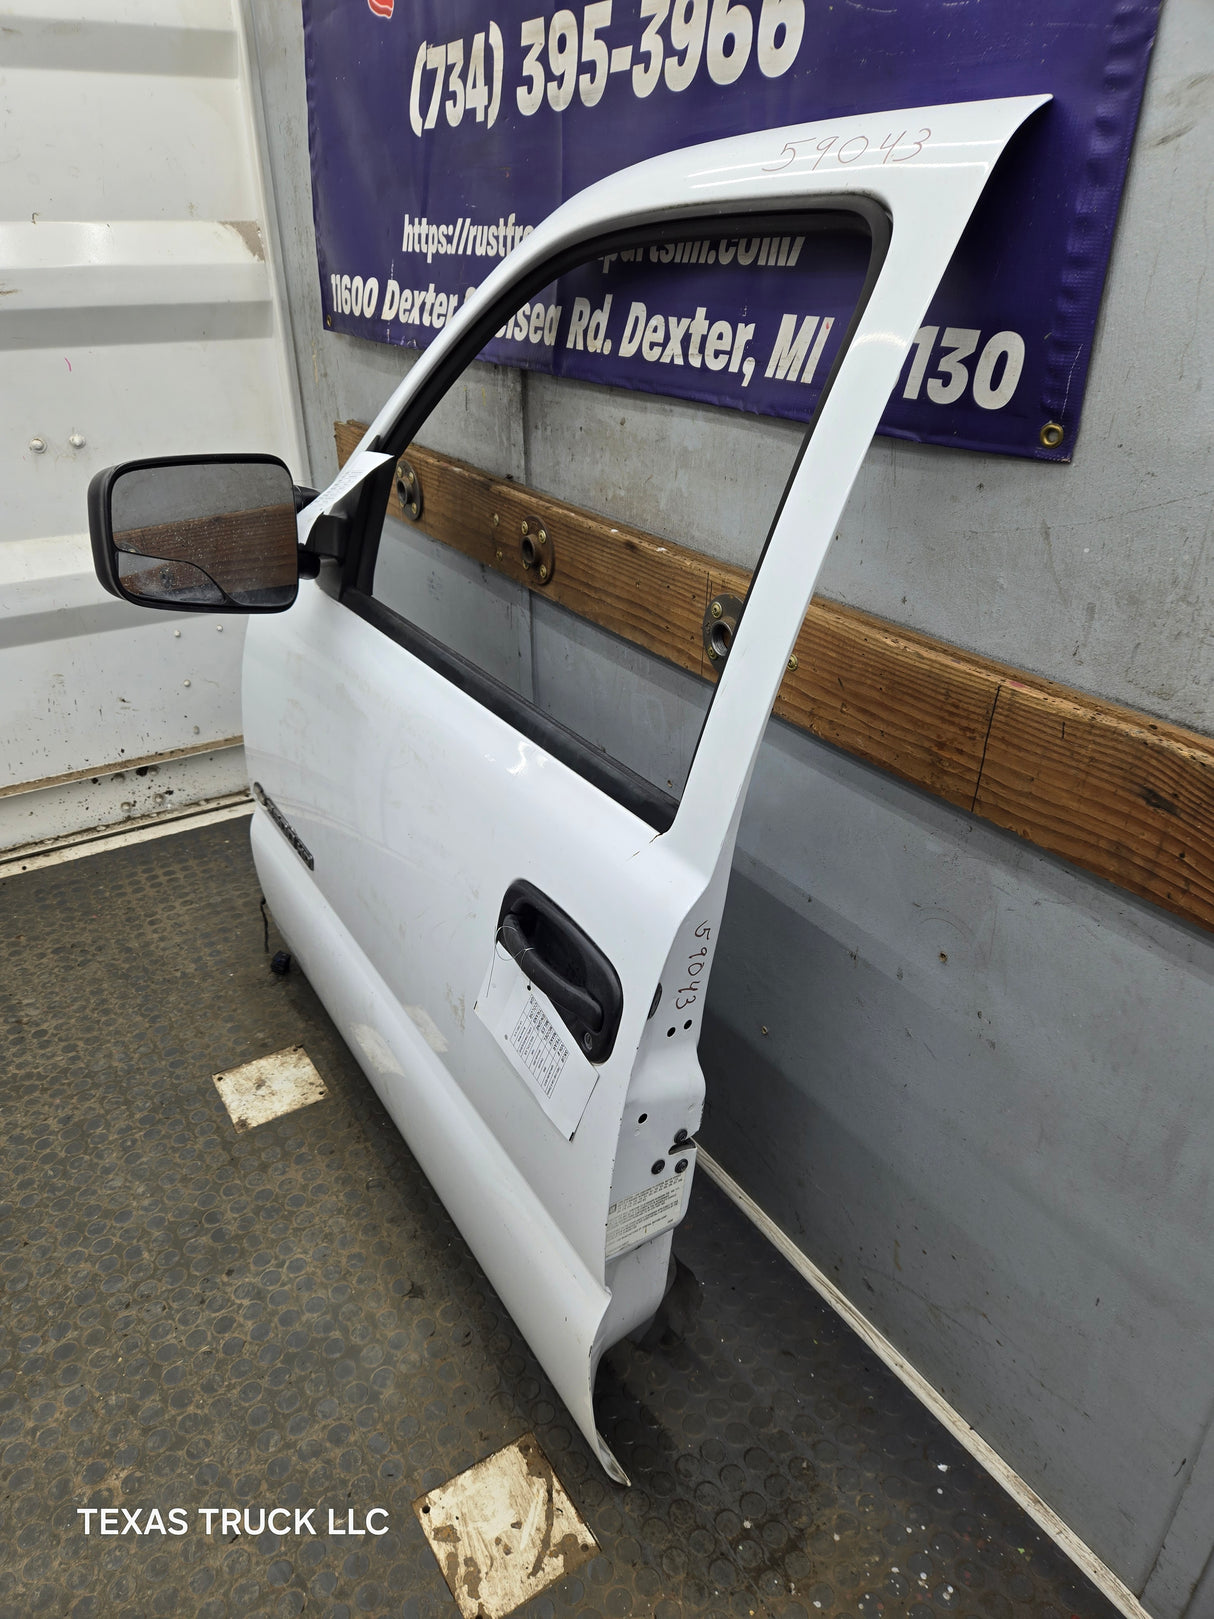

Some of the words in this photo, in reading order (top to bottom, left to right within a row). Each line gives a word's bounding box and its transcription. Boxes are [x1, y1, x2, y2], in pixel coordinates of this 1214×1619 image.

[409, 20, 504, 138] (734)
[516, 0, 806, 117] 395-3966
[761, 127, 932, 172] 59043
[330, 273, 380, 319] 11600
[381, 279, 459, 329] Dexter
[566, 293, 614, 356] Rd.
[618, 301, 757, 387] Dexter,
[764, 313, 836, 384] MI
[675, 919, 711, 1010] 59043
